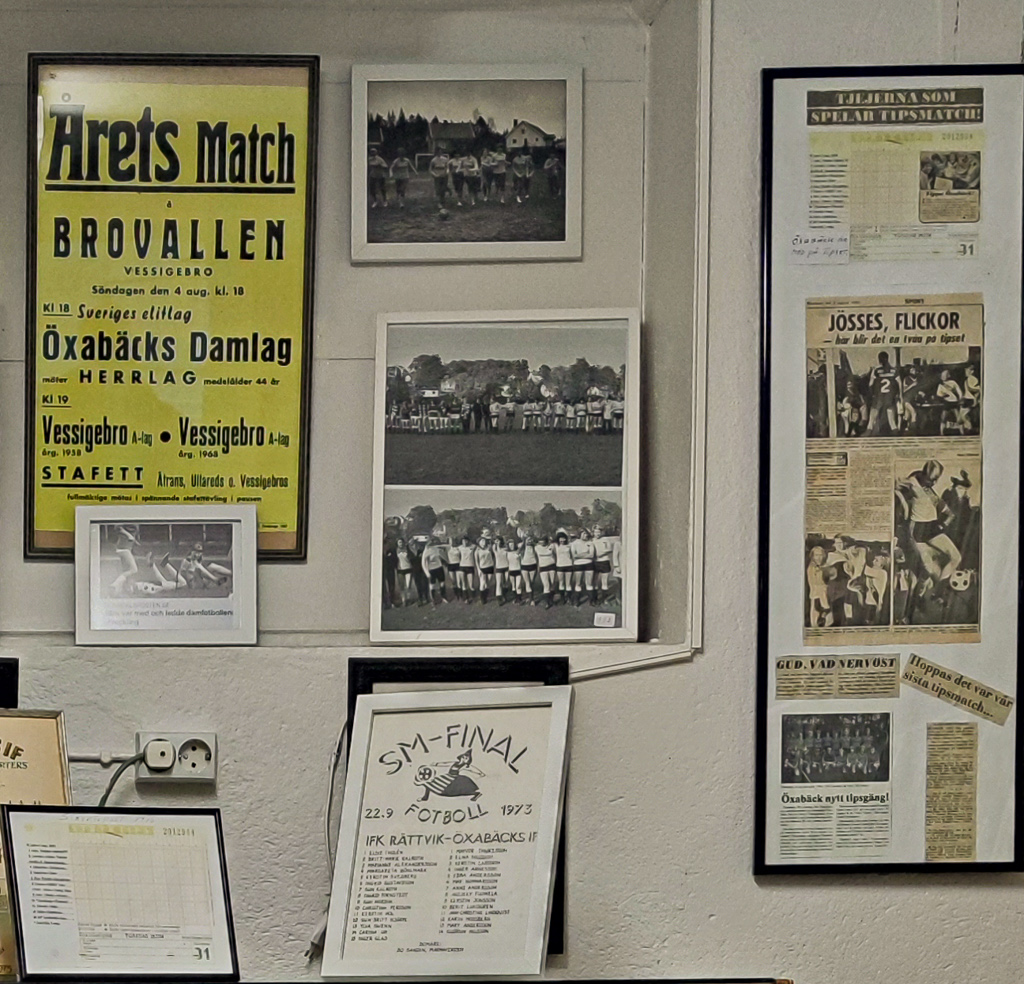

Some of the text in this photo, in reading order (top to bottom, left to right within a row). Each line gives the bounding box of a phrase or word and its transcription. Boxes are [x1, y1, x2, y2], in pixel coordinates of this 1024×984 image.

[922, 91, 957, 103] SOM
[811, 112, 874, 123] SPELAR
[196, 121, 295, 184] Match
[54, 217, 285, 260] BROVALLEN
[124, 267, 213, 277] VESSIGEBRO
[92, 285, 244, 297] Söndagen den 4 aug. kl. 18
[59, 304, 70, 313] 18
[78, 304, 192, 324] Sveriges elitlag
[828, 310, 960, 332] JÖSSES, FLICKOR
[43, 325, 292, 366] Öxabäcks Damlag
[853, 334, 868, 344] blir
[872, 334, 885, 344] det
[941, 333, 965, 344] tipset
[42, 376, 68, 384] möter
[79, 370, 197, 384] HERRLAG
[881, 379, 890, 393] 2
[58, 395, 69, 404] 19
[42, 415, 152, 453] Vessigebro A-lag
[179, 417, 289, 454] Vessigebro A-lag
[42, 466, 143, 480] STAFETT
[191, 473, 224, 488] Ullareds
[240, 475, 288, 490] Vessigebros
[810, 660, 835, 669] VAD
[838, 658, 896, 668] NERVÖST
[903, 671, 928, 689] sista
[910, 654, 952, 682] Hoppas
[954, 675, 972, 690] det
[974, 684, 993, 700] var
[3, 742, 24, 760] IF
[379, 724, 528, 776] SM-FINAL
[781, 792, 889, 804] Öxabäck nytt tipsgäng!
[365, 804, 532, 824] 22.9 FOTBOLL 1973
[366, 831, 538, 847] IFK RÄTTVIK-ÖXABÄCKS IF
